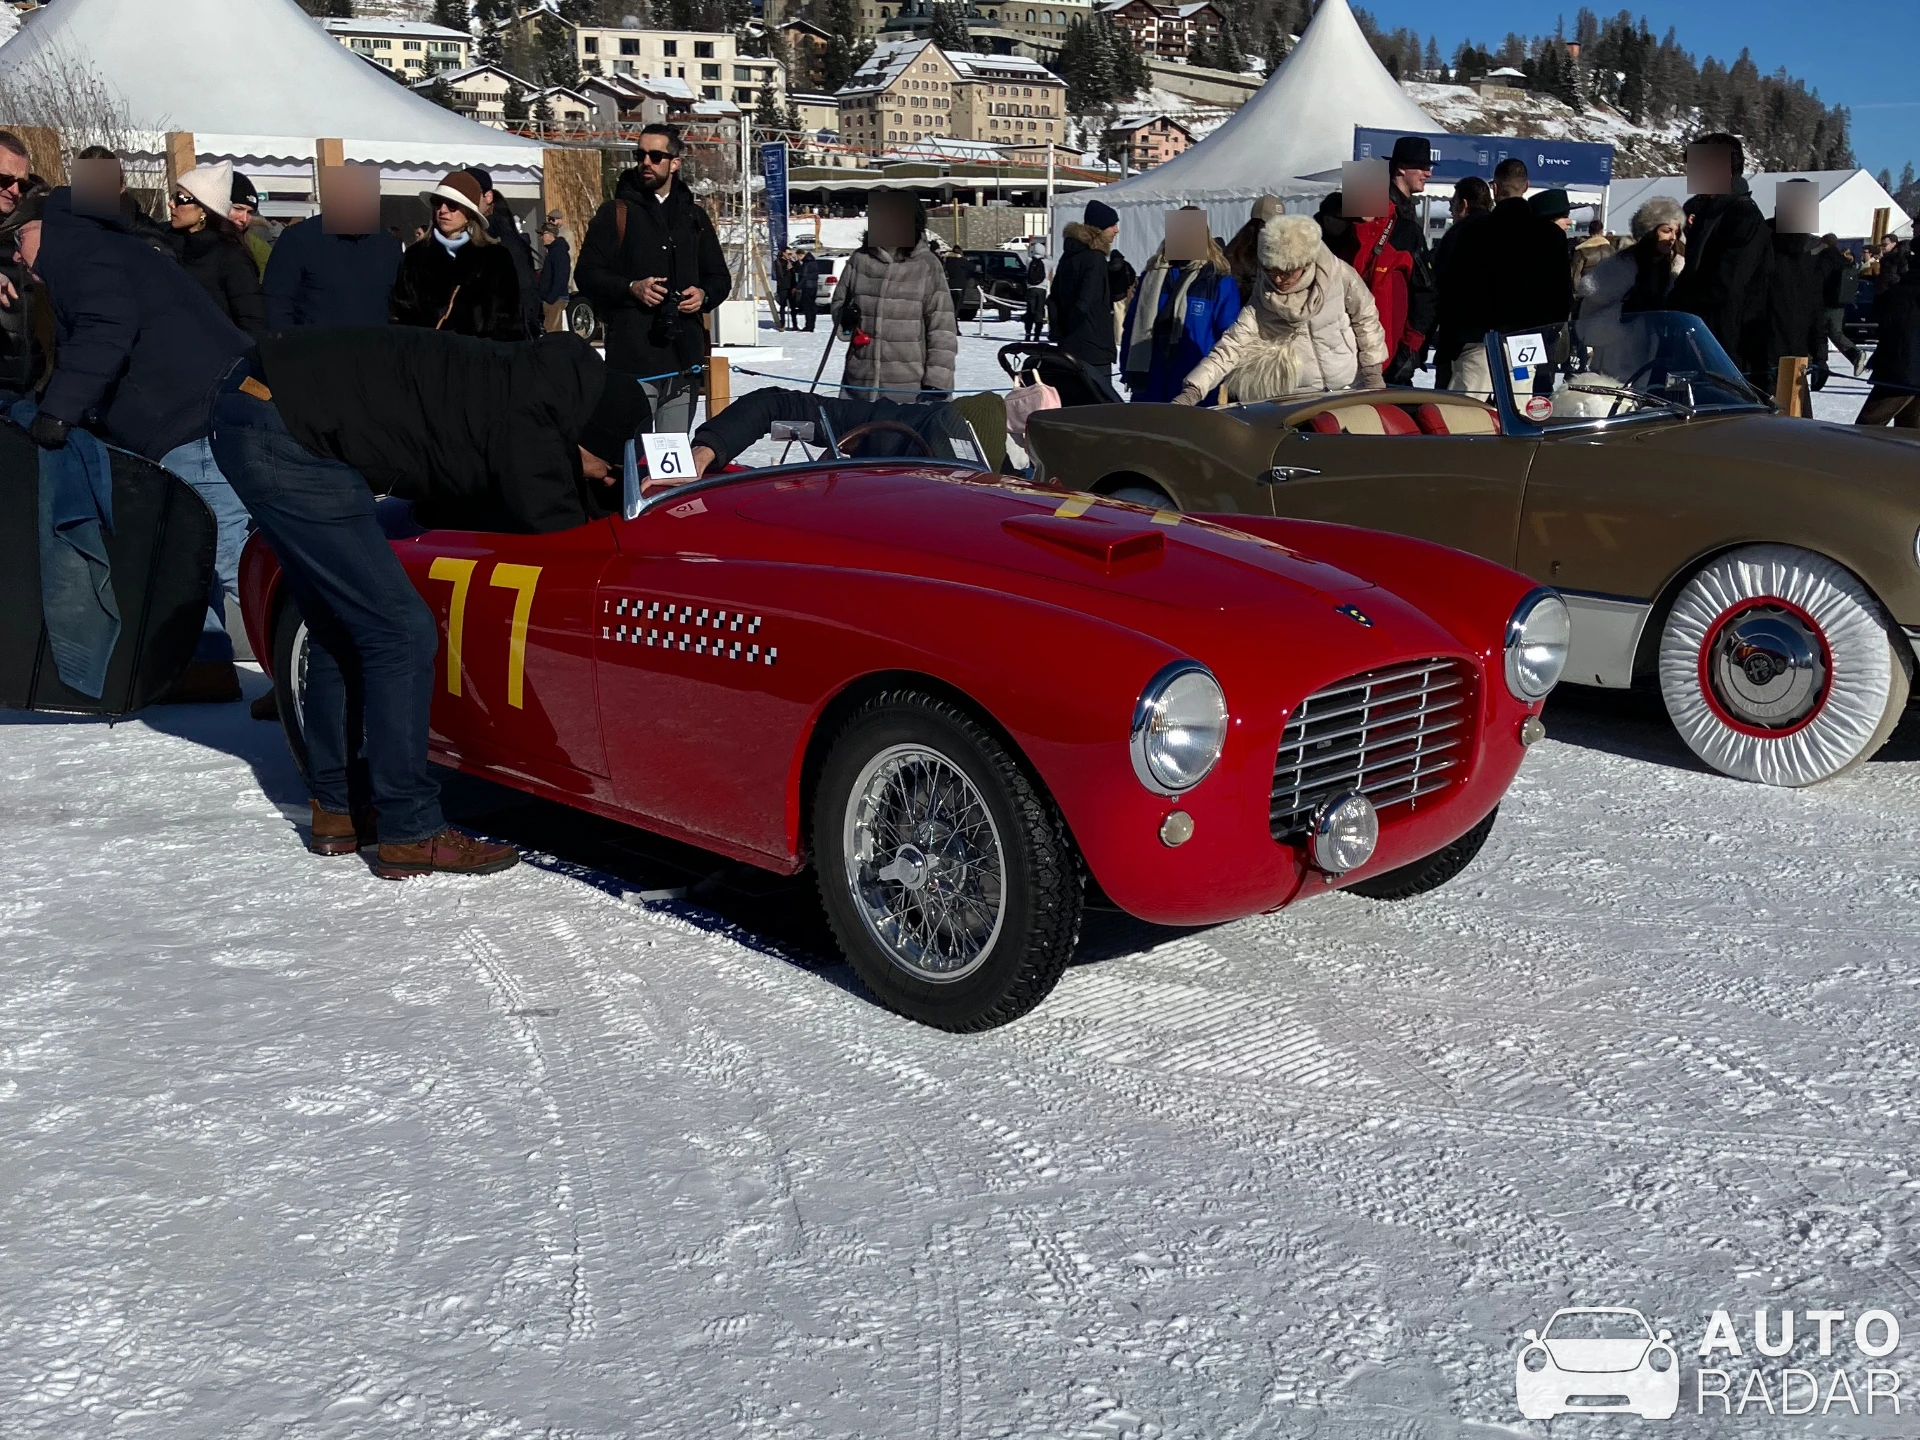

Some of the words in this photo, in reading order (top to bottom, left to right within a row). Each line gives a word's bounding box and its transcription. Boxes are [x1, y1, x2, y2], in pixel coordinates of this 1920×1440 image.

[1518, 346, 1537, 363] 67
[660, 451, 682, 474] 61
[428, 556, 544, 710] 77
